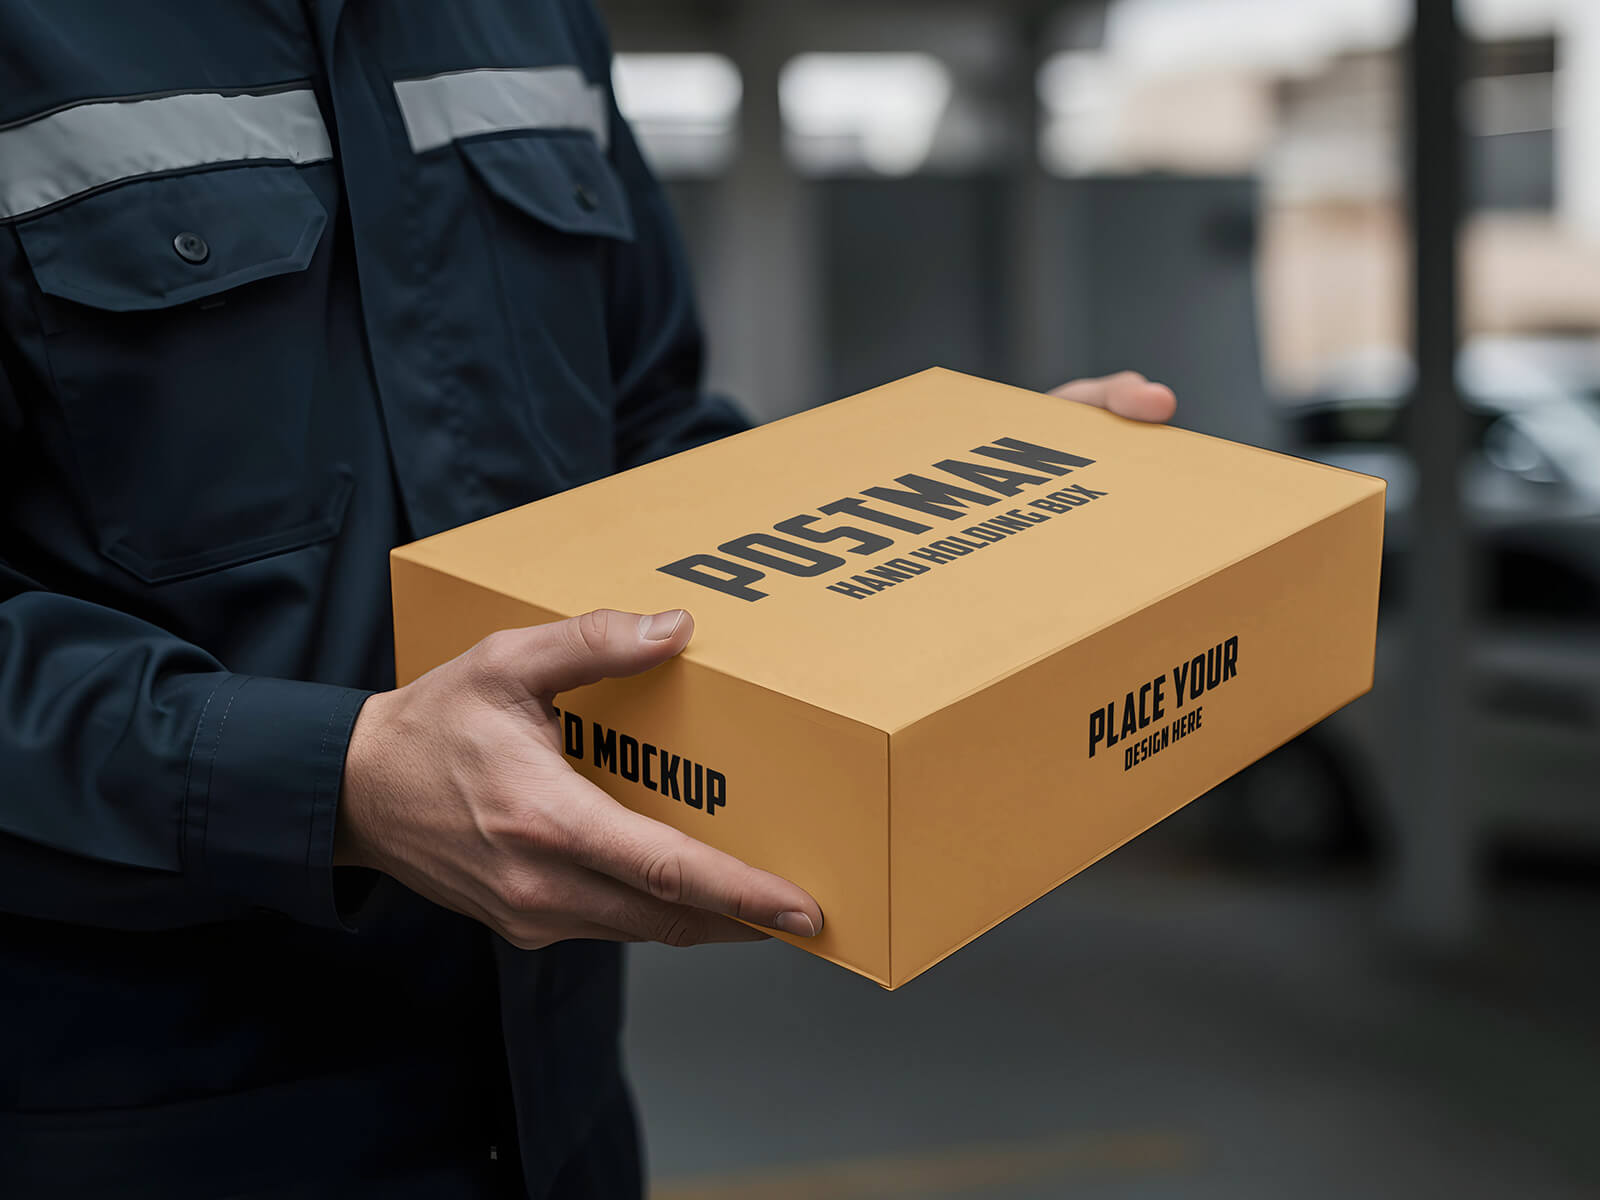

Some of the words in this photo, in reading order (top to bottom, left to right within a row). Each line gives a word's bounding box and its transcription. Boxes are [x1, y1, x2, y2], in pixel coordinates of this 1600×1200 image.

[655, 436, 1097, 603] POSTMAN
[825, 558, 932, 600] HAND
[908, 508, 1052, 565] HOLDING
[1027, 483, 1109, 515] BOX
[1088, 674, 1166, 759] PLACE
[1172, 635, 1239, 709] YOUR
[1124, 725, 1170, 772] DESIGN
[1171, 706, 1203, 744] HERE
[553, 706, 584, 761] D
[592, 721, 727, 816] MOCKUP
